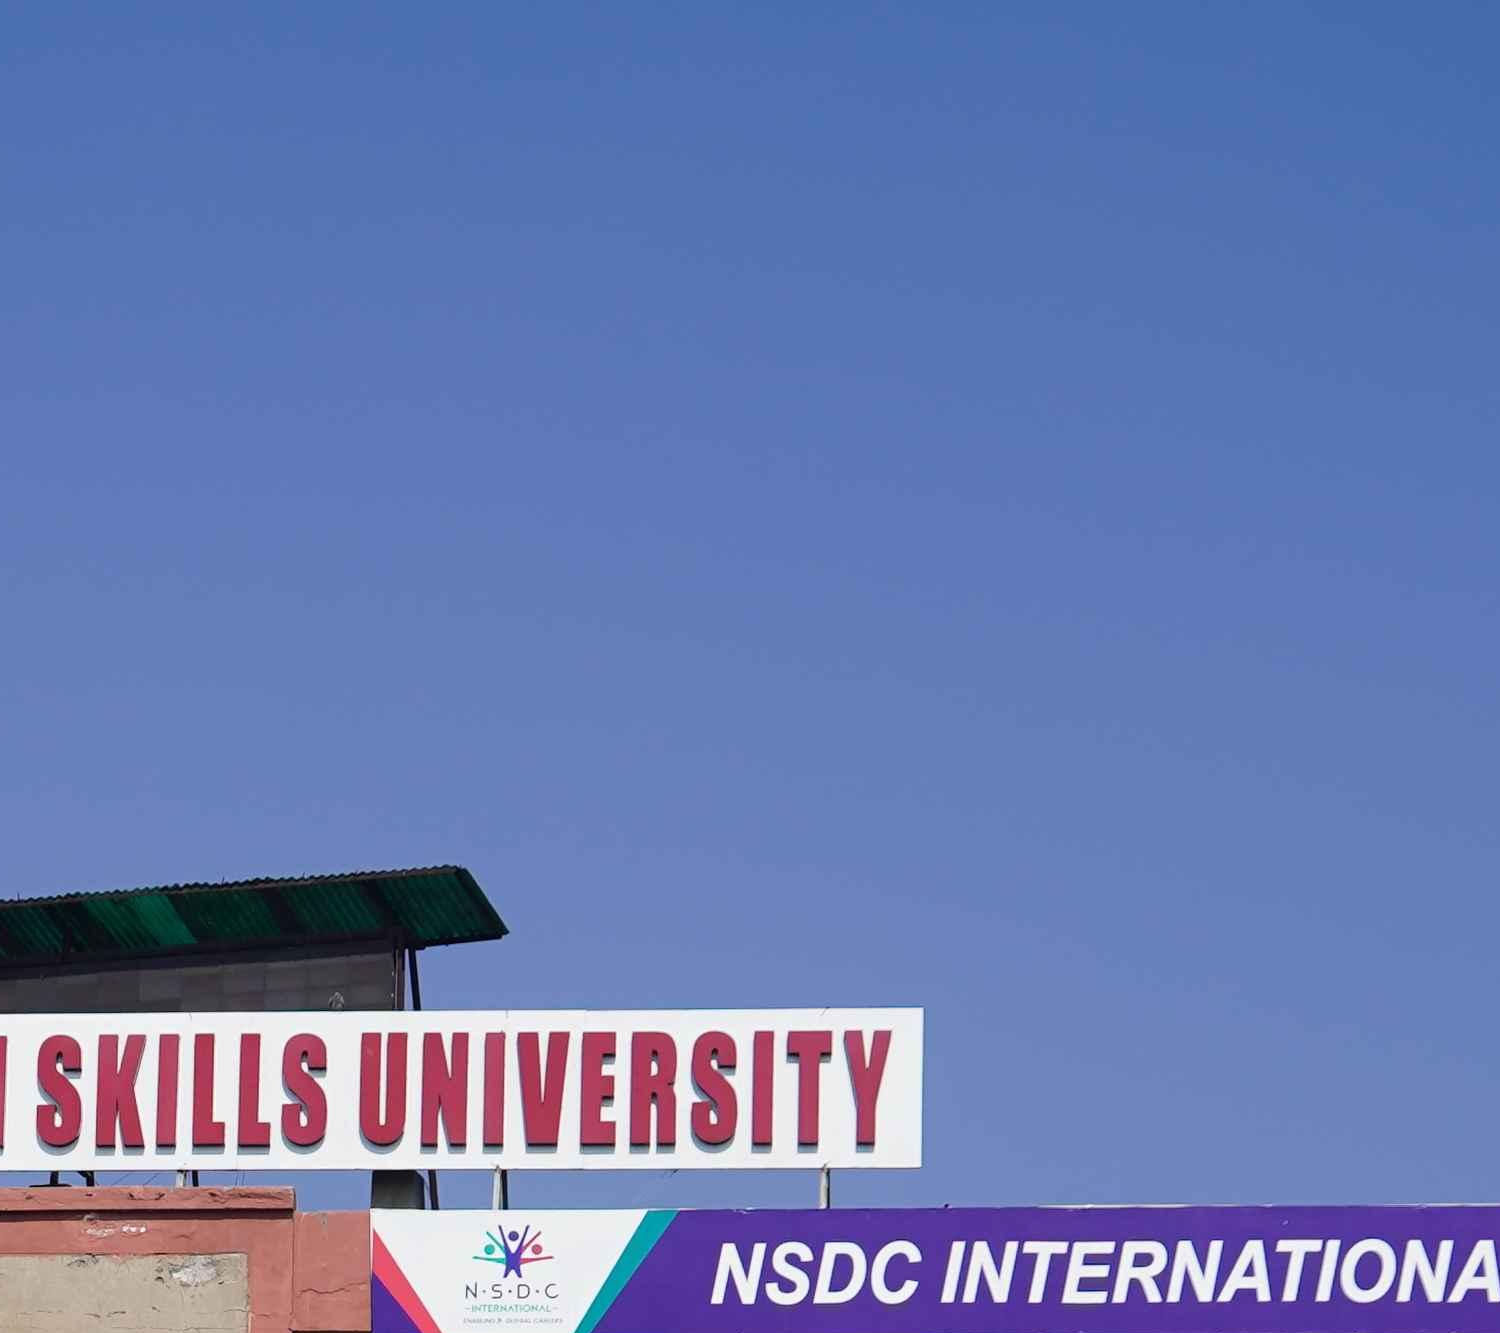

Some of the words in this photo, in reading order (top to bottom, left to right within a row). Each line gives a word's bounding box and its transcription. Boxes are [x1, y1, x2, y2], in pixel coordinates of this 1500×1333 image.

[36, 1034, 328, 1146] SKILLS
[359, 1030, 892, 1146] UNIVERSITY
[710, 1240, 921, 1305] NSDC
